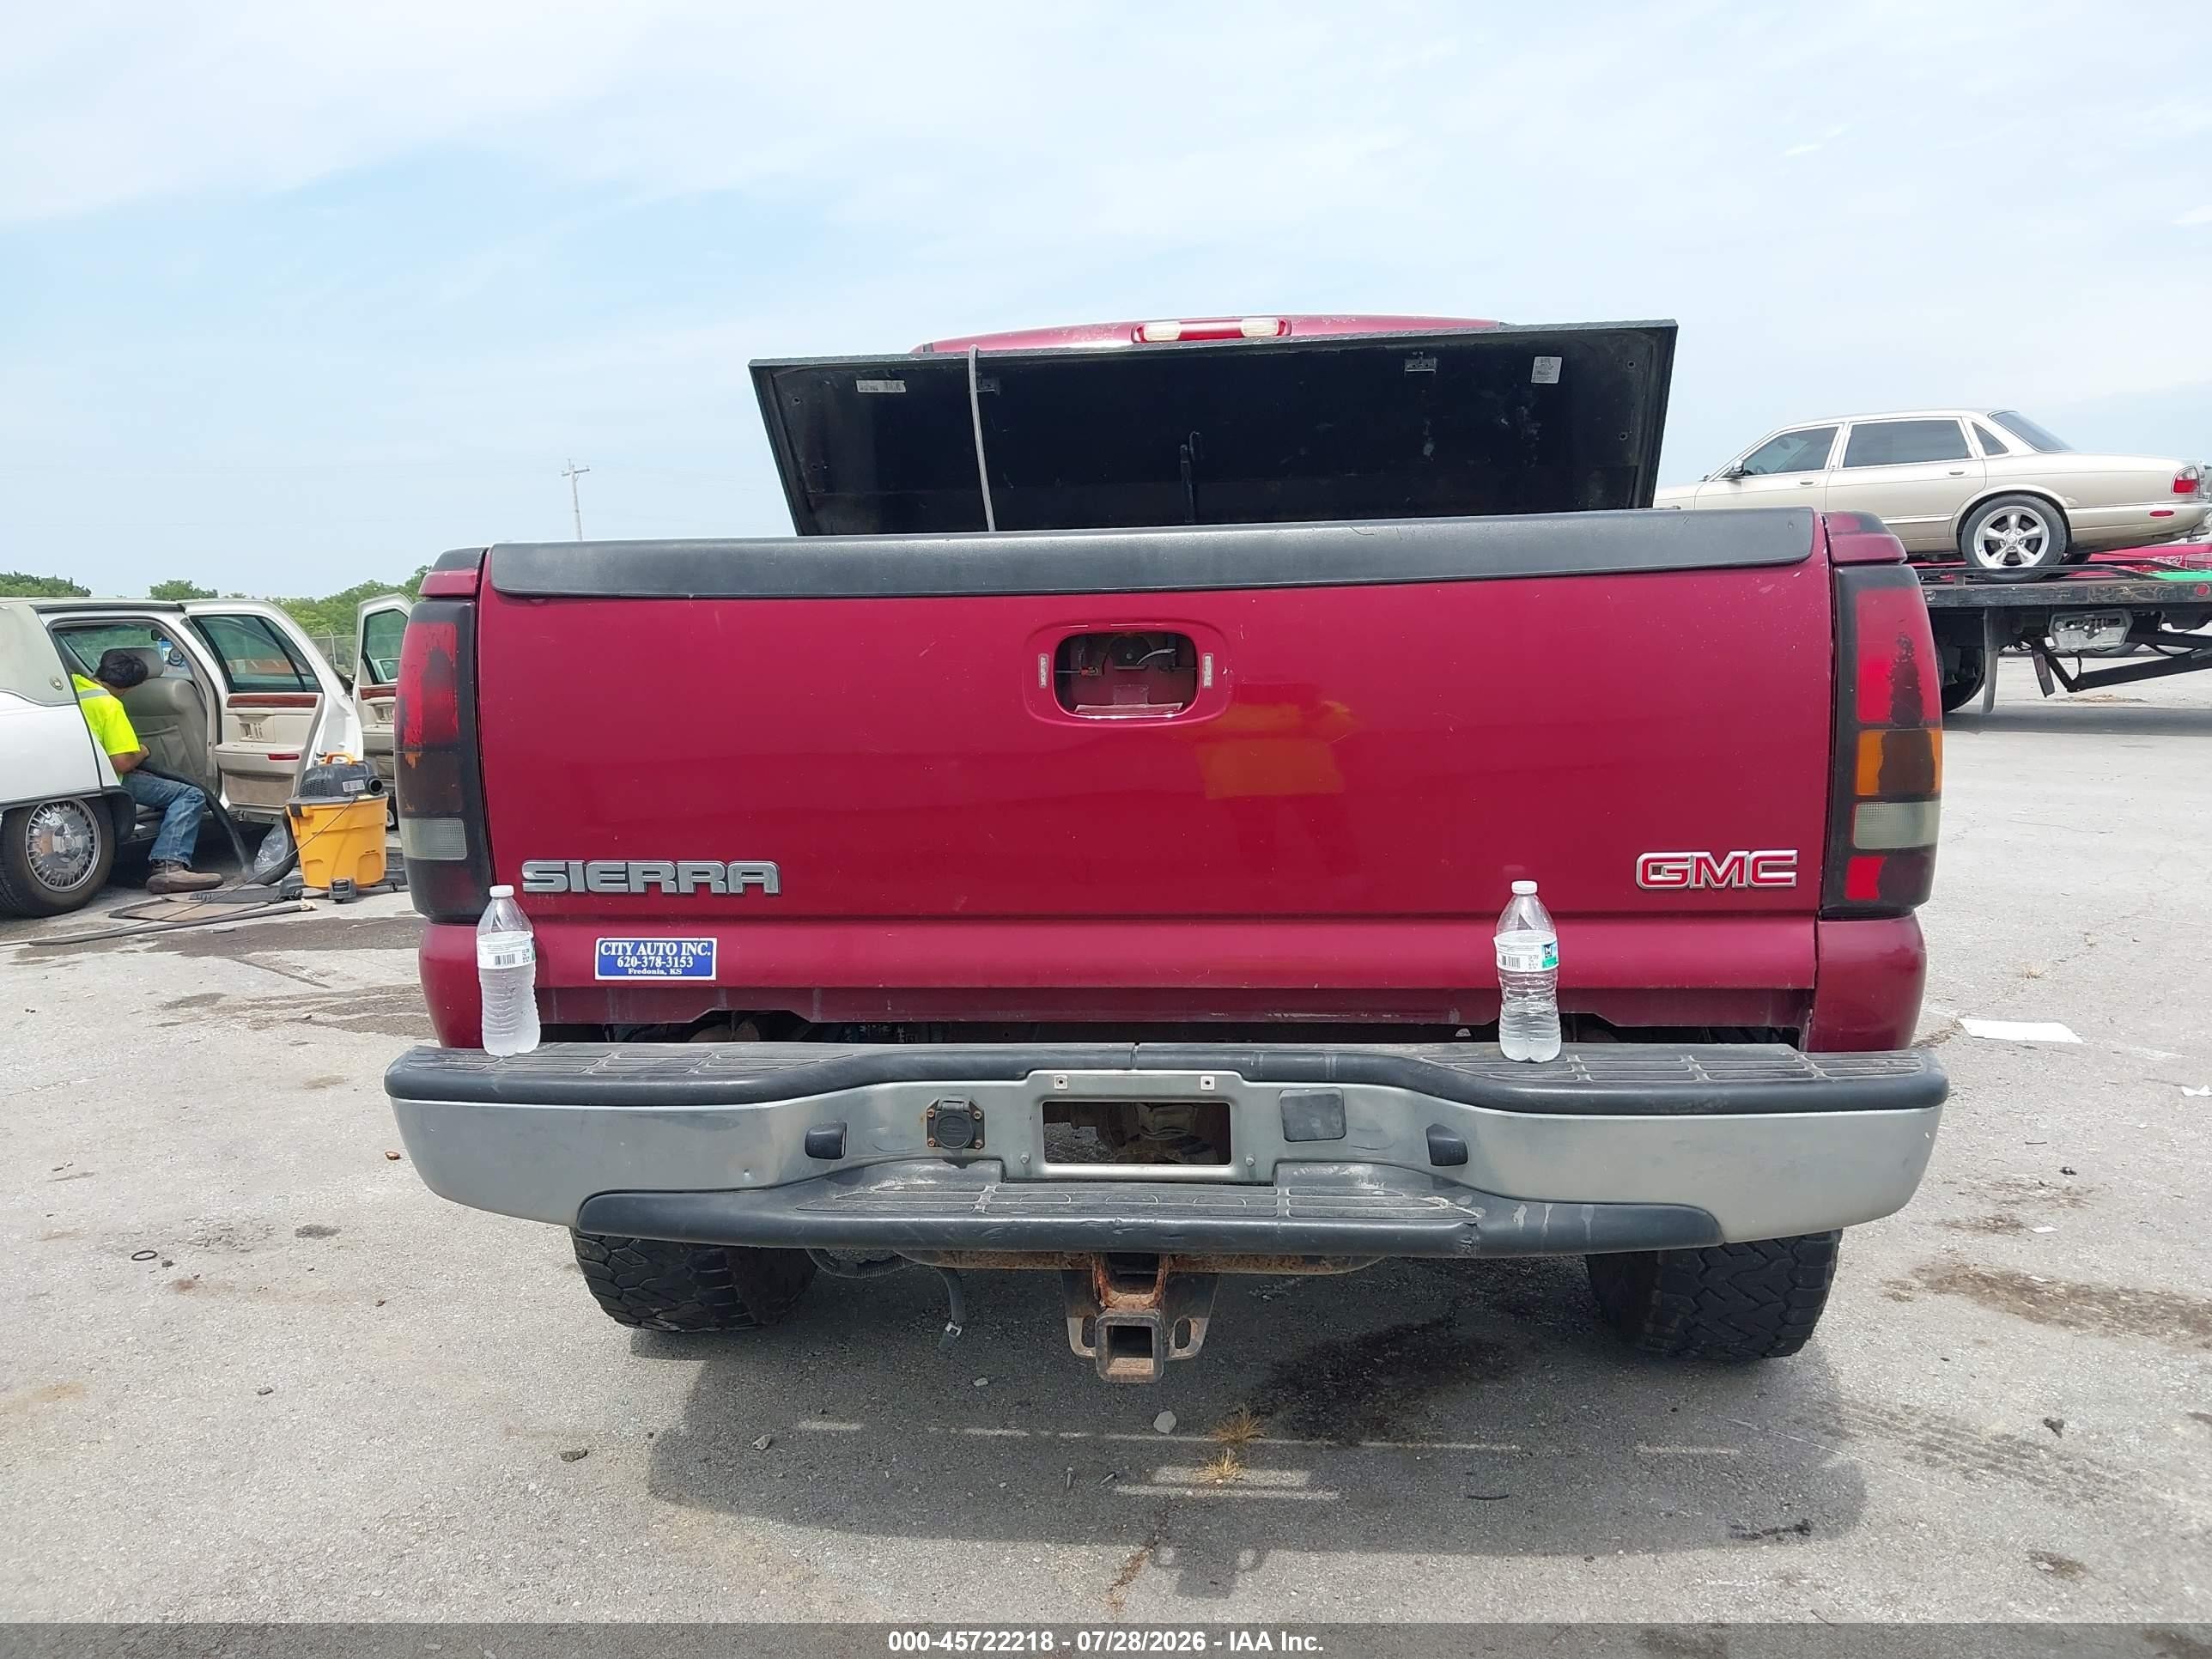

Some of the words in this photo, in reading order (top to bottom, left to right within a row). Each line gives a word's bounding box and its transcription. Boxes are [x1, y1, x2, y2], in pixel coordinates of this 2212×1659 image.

[522, 860, 781, 895] SIERRA
[1636, 849, 1798, 889] GMC
[601, 942, 635, 955] CITY
[636, 942, 677, 955] AUTO
[681, 942, 711, 956] INC.
[617, 956, 693, 968] 620-378-3153
